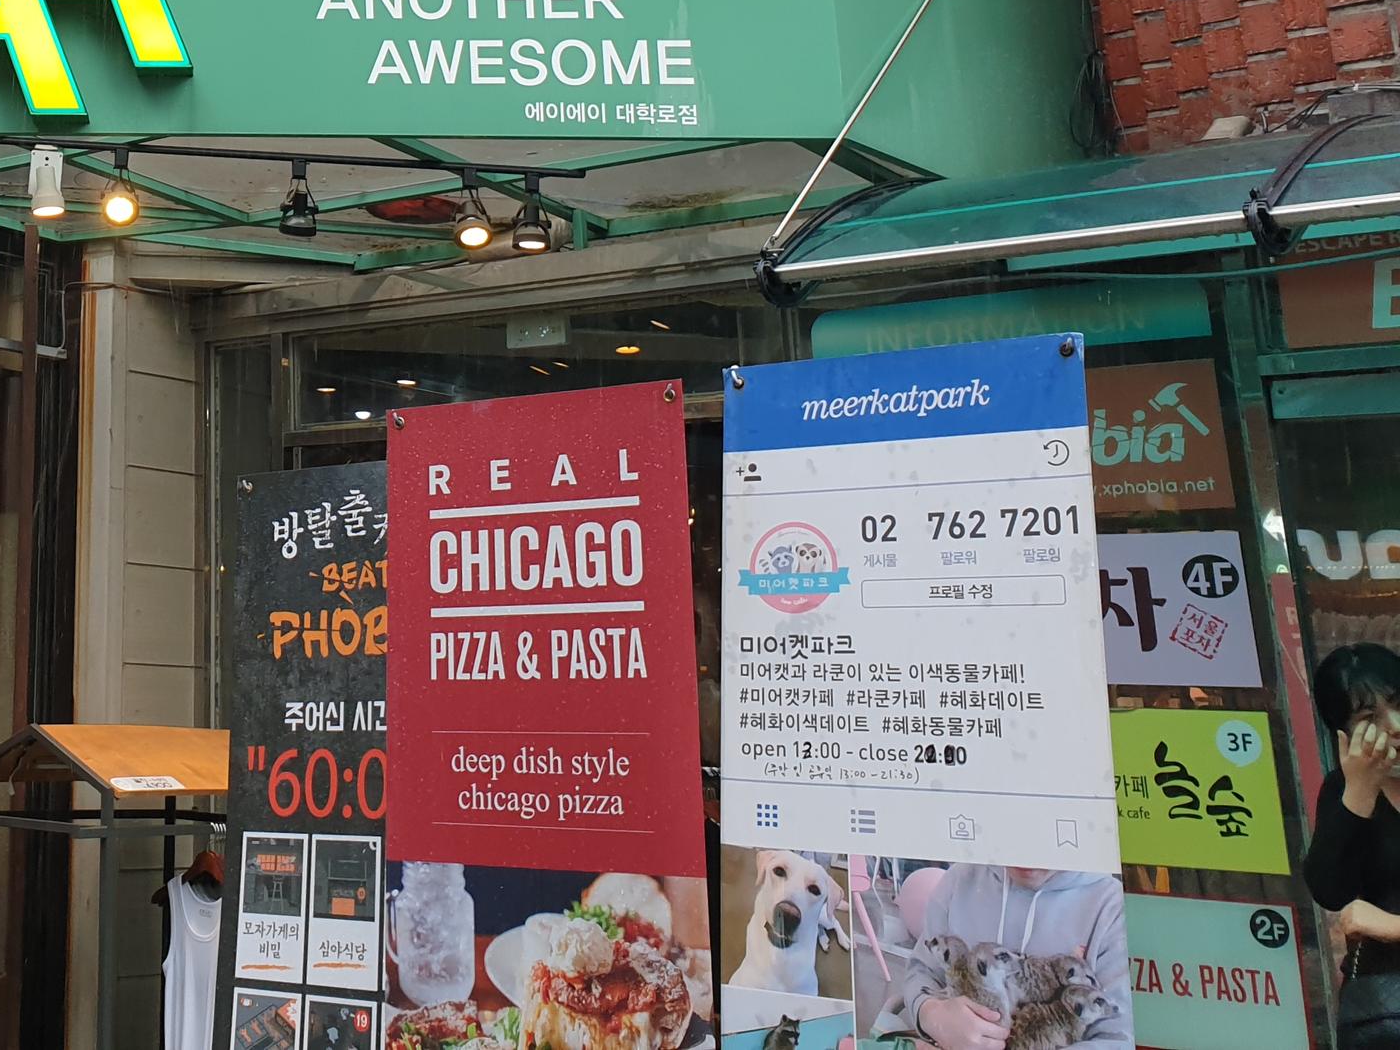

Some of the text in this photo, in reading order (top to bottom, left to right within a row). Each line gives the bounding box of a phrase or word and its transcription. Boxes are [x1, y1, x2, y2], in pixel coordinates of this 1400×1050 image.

[366, 38, 696, 87] AWESOME
[524, 101, 699, 126] 에이에이 대학로점
[800, 377, 992, 422] meerkatpark
[428, 449, 639, 496] REAL
[861, 504, 1081, 544] 02 762 7201
[429, 519, 644, 595] CHICAGO
[863, 547, 1062, 569] 게시물 팔로워 팔로잉
[1186, 561, 1234, 596] 4F
[928, 583, 994, 600] 프로필 수정
[430, 627, 648, 681] PIZZA & PASTA
[739, 661, 1026, 685] 미어캣과 라쿤이 있는 이색동물카페!
[739, 687, 1045, 712] #미어캣카페 #라쿤카페 #혜화데이트
[739, 712, 1003, 739] #혜화이색데이트 #혜화동물카페
[741, 742, 787, 760] open
[858, 742, 909, 763] close
[1226, 731, 1253, 752] 3F
[450, 745, 631, 785] deep dish style
[457, 782, 625, 822] chicago pizza
[1127, 806, 1151, 820] cafe
[243, 920, 300, 942] 모자가게의
[1254, 915, 1286, 941] 2F
[259, 940, 281, 960] 비밀
[319, 940, 368, 962] 심야식당
[1172, 962, 1193, 998] &
[1199, 964, 1281, 1007] PASTA
[355, 1013, 369, 1028] 19
